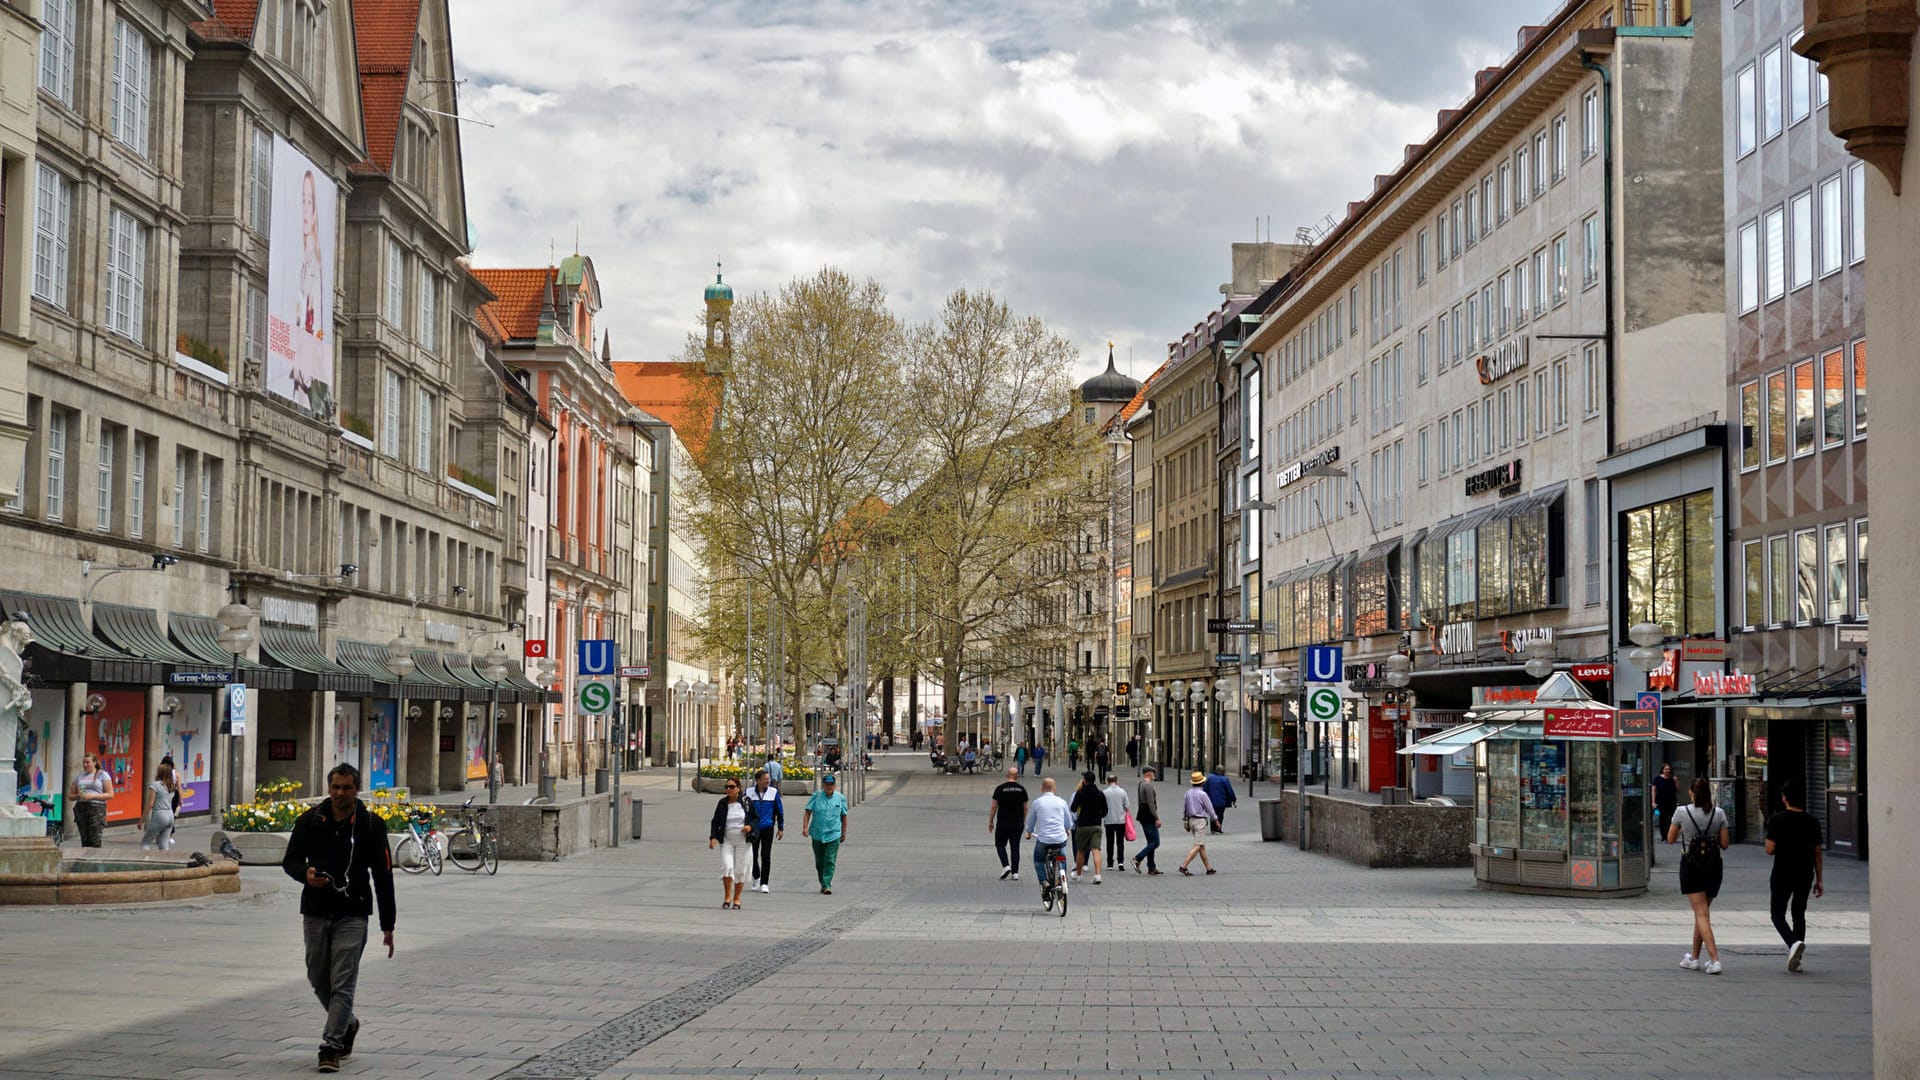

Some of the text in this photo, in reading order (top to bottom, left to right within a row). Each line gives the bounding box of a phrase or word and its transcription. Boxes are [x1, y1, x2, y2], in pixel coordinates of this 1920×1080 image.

[1488, 335, 1523, 382] SATURN
[1276, 461, 1301, 489] TRETTER
[1440, 621, 1473, 655] SATURN
[585, 642, 607, 673] U
[1314, 649, 1336, 679] U
[174, 672, 228, 683] Herzog-Max-Str.
[1693, 668, 1754, 695] Foot Locker
[585, 685, 605, 709] S
[1315, 692, 1335, 717] S
